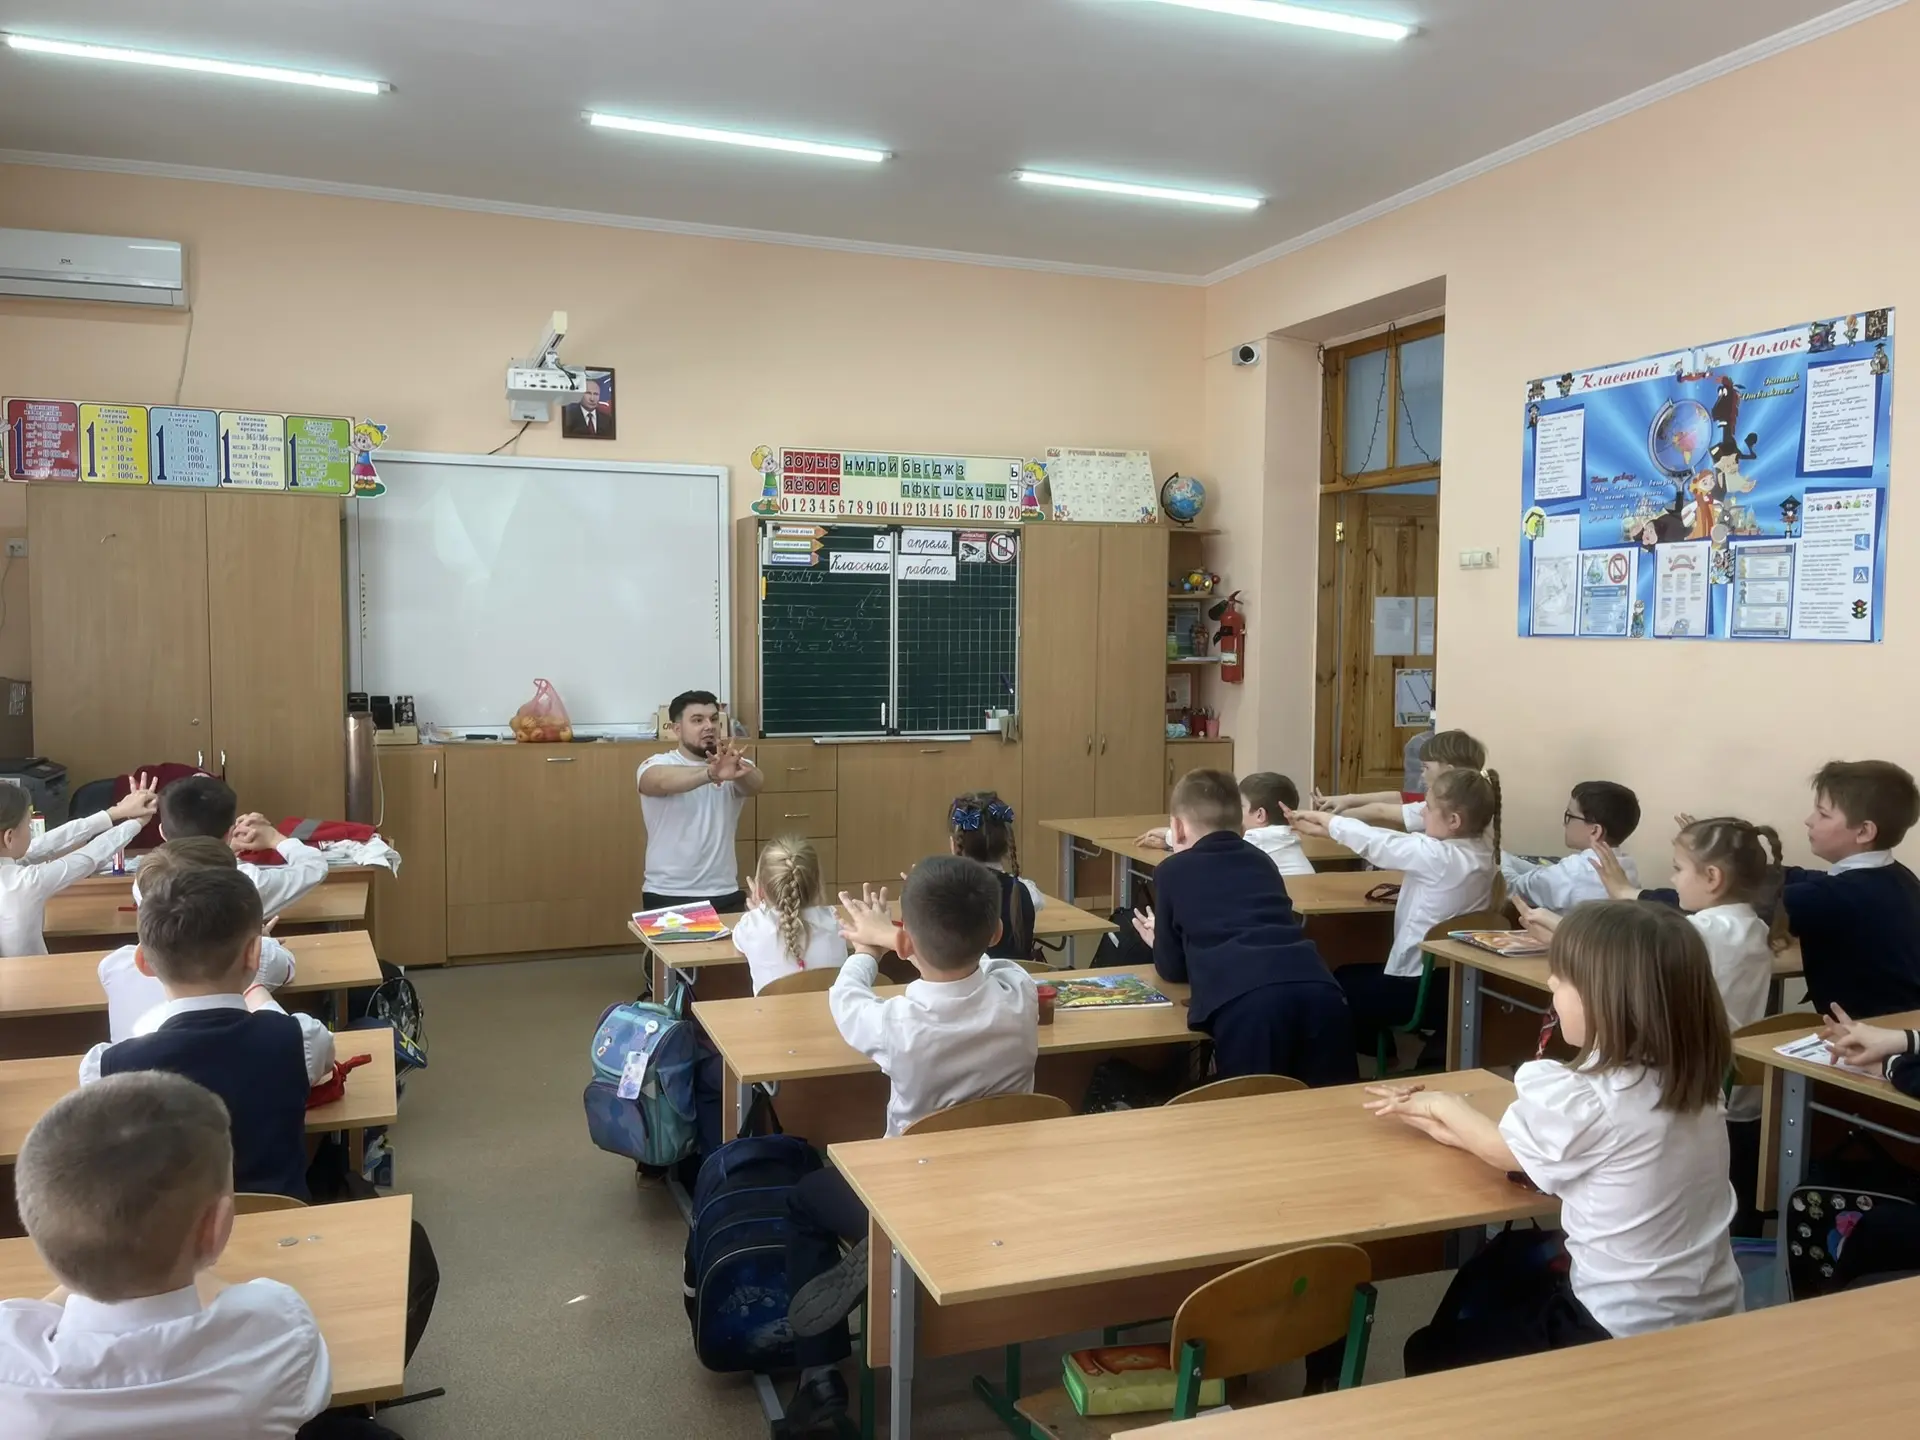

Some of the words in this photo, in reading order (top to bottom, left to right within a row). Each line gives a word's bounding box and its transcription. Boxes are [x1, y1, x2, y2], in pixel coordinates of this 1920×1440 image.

[1581, 363, 1660, 389] Классный
[1728, 336, 1802, 364] Уголок
[116, 425, 132, 434] 1000
[116, 434, 125, 443] 10
[116, 443, 125, 452] 10
[116, 453, 125, 462] 10
[118, 462, 130, 471] 100
[118, 471, 134, 480] 1000
[782, 498, 788, 512] 0
[792, 498, 796, 512] 1
[800, 498, 806, 512] 2
[809, 499, 816, 513] 3
[820, 500, 826, 513] 4
[829, 500, 835, 514] 5
[838, 500, 844, 514] 6
[848, 500, 854, 514] 7
[857, 500, 863, 514] 8
[866, 501, 872, 514] 9
[876, 501, 888, 515] 10
[890, 502, 899, 516] 11
[902, 502, 912, 516] 12
[916, 502, 926, 516] 13
[929, 503, 940, 517] 14
[943, 504, 954, 518] 15
[956, 504, 967, 518] 16
[970, 504, 980, 518] 17
[982, 505, 992, 519] 18
[996, 505, 1006, 519] 19
[1008, 506, 1020, 520] 20
[876, 536, 886, 549] 6
[907, 538, 950, 554] апреля.
[830, 554, 890, 570] Классная
